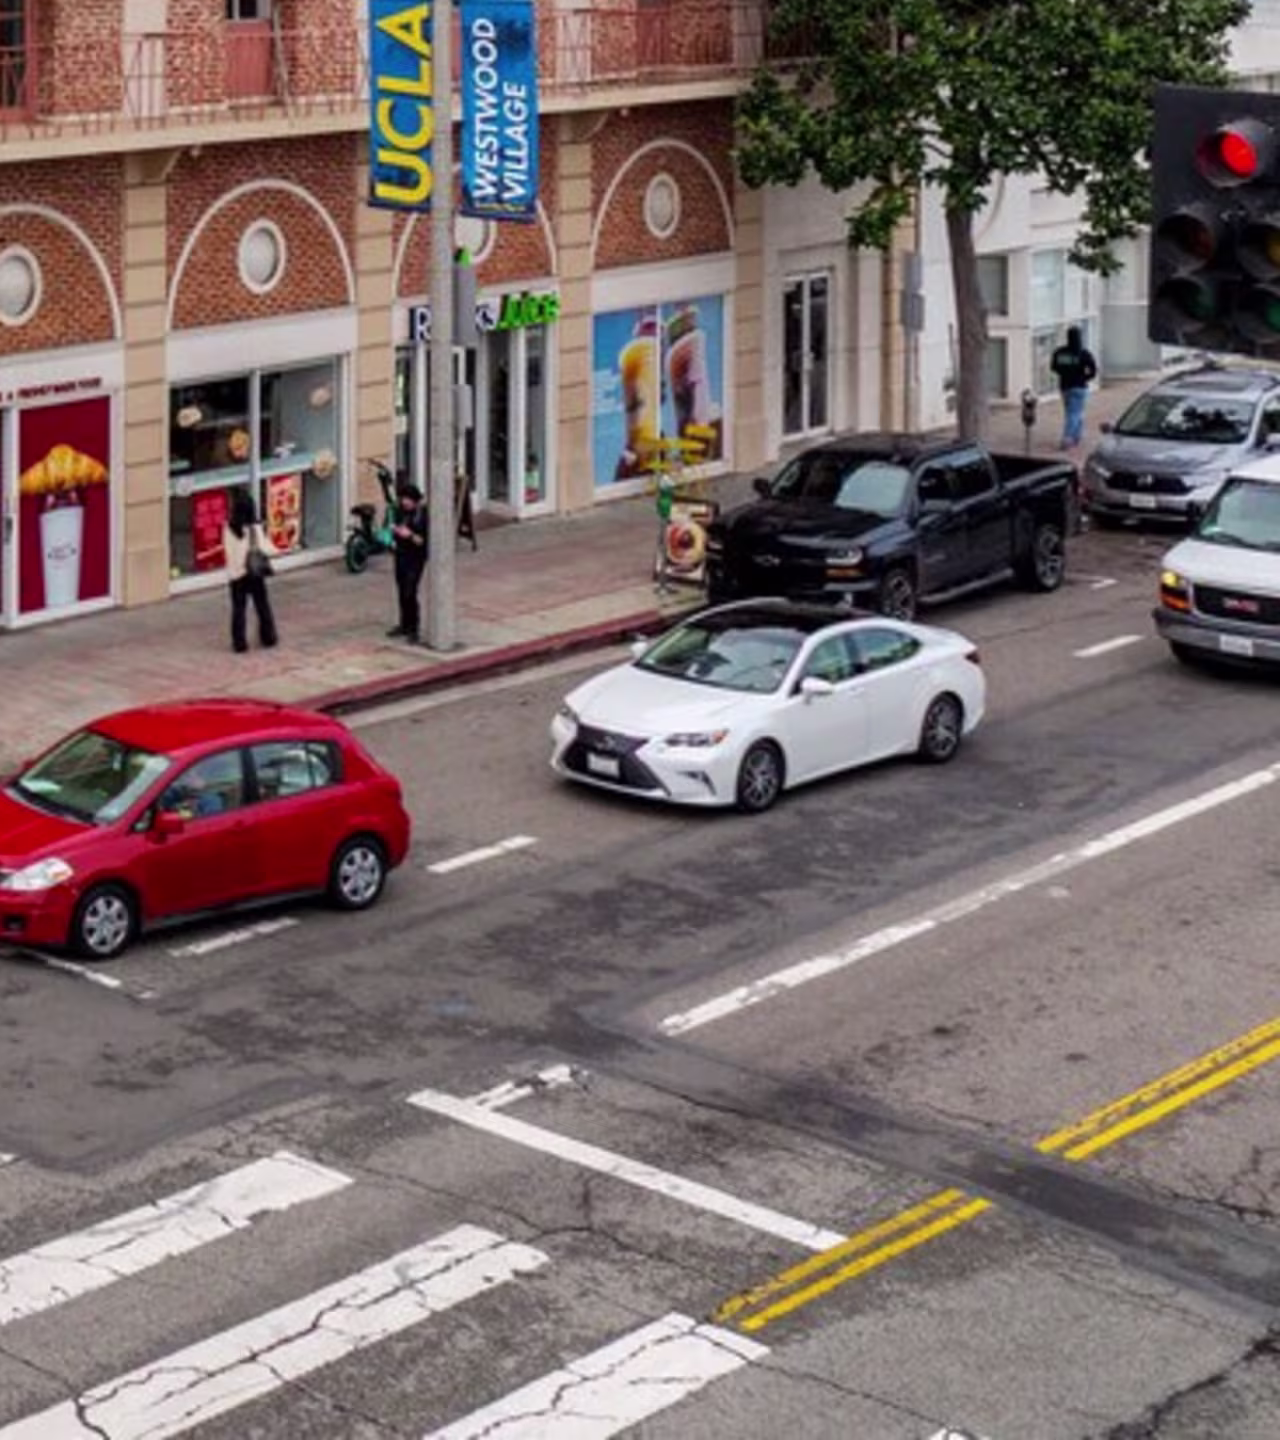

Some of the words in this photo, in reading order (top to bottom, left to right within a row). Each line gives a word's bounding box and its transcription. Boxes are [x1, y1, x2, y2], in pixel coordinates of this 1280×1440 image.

[374, 3, 434, 204] UCLA
[471, 17, 499, 198] WESTWOOD
[501, 80, 530, 199] VILLAGE
